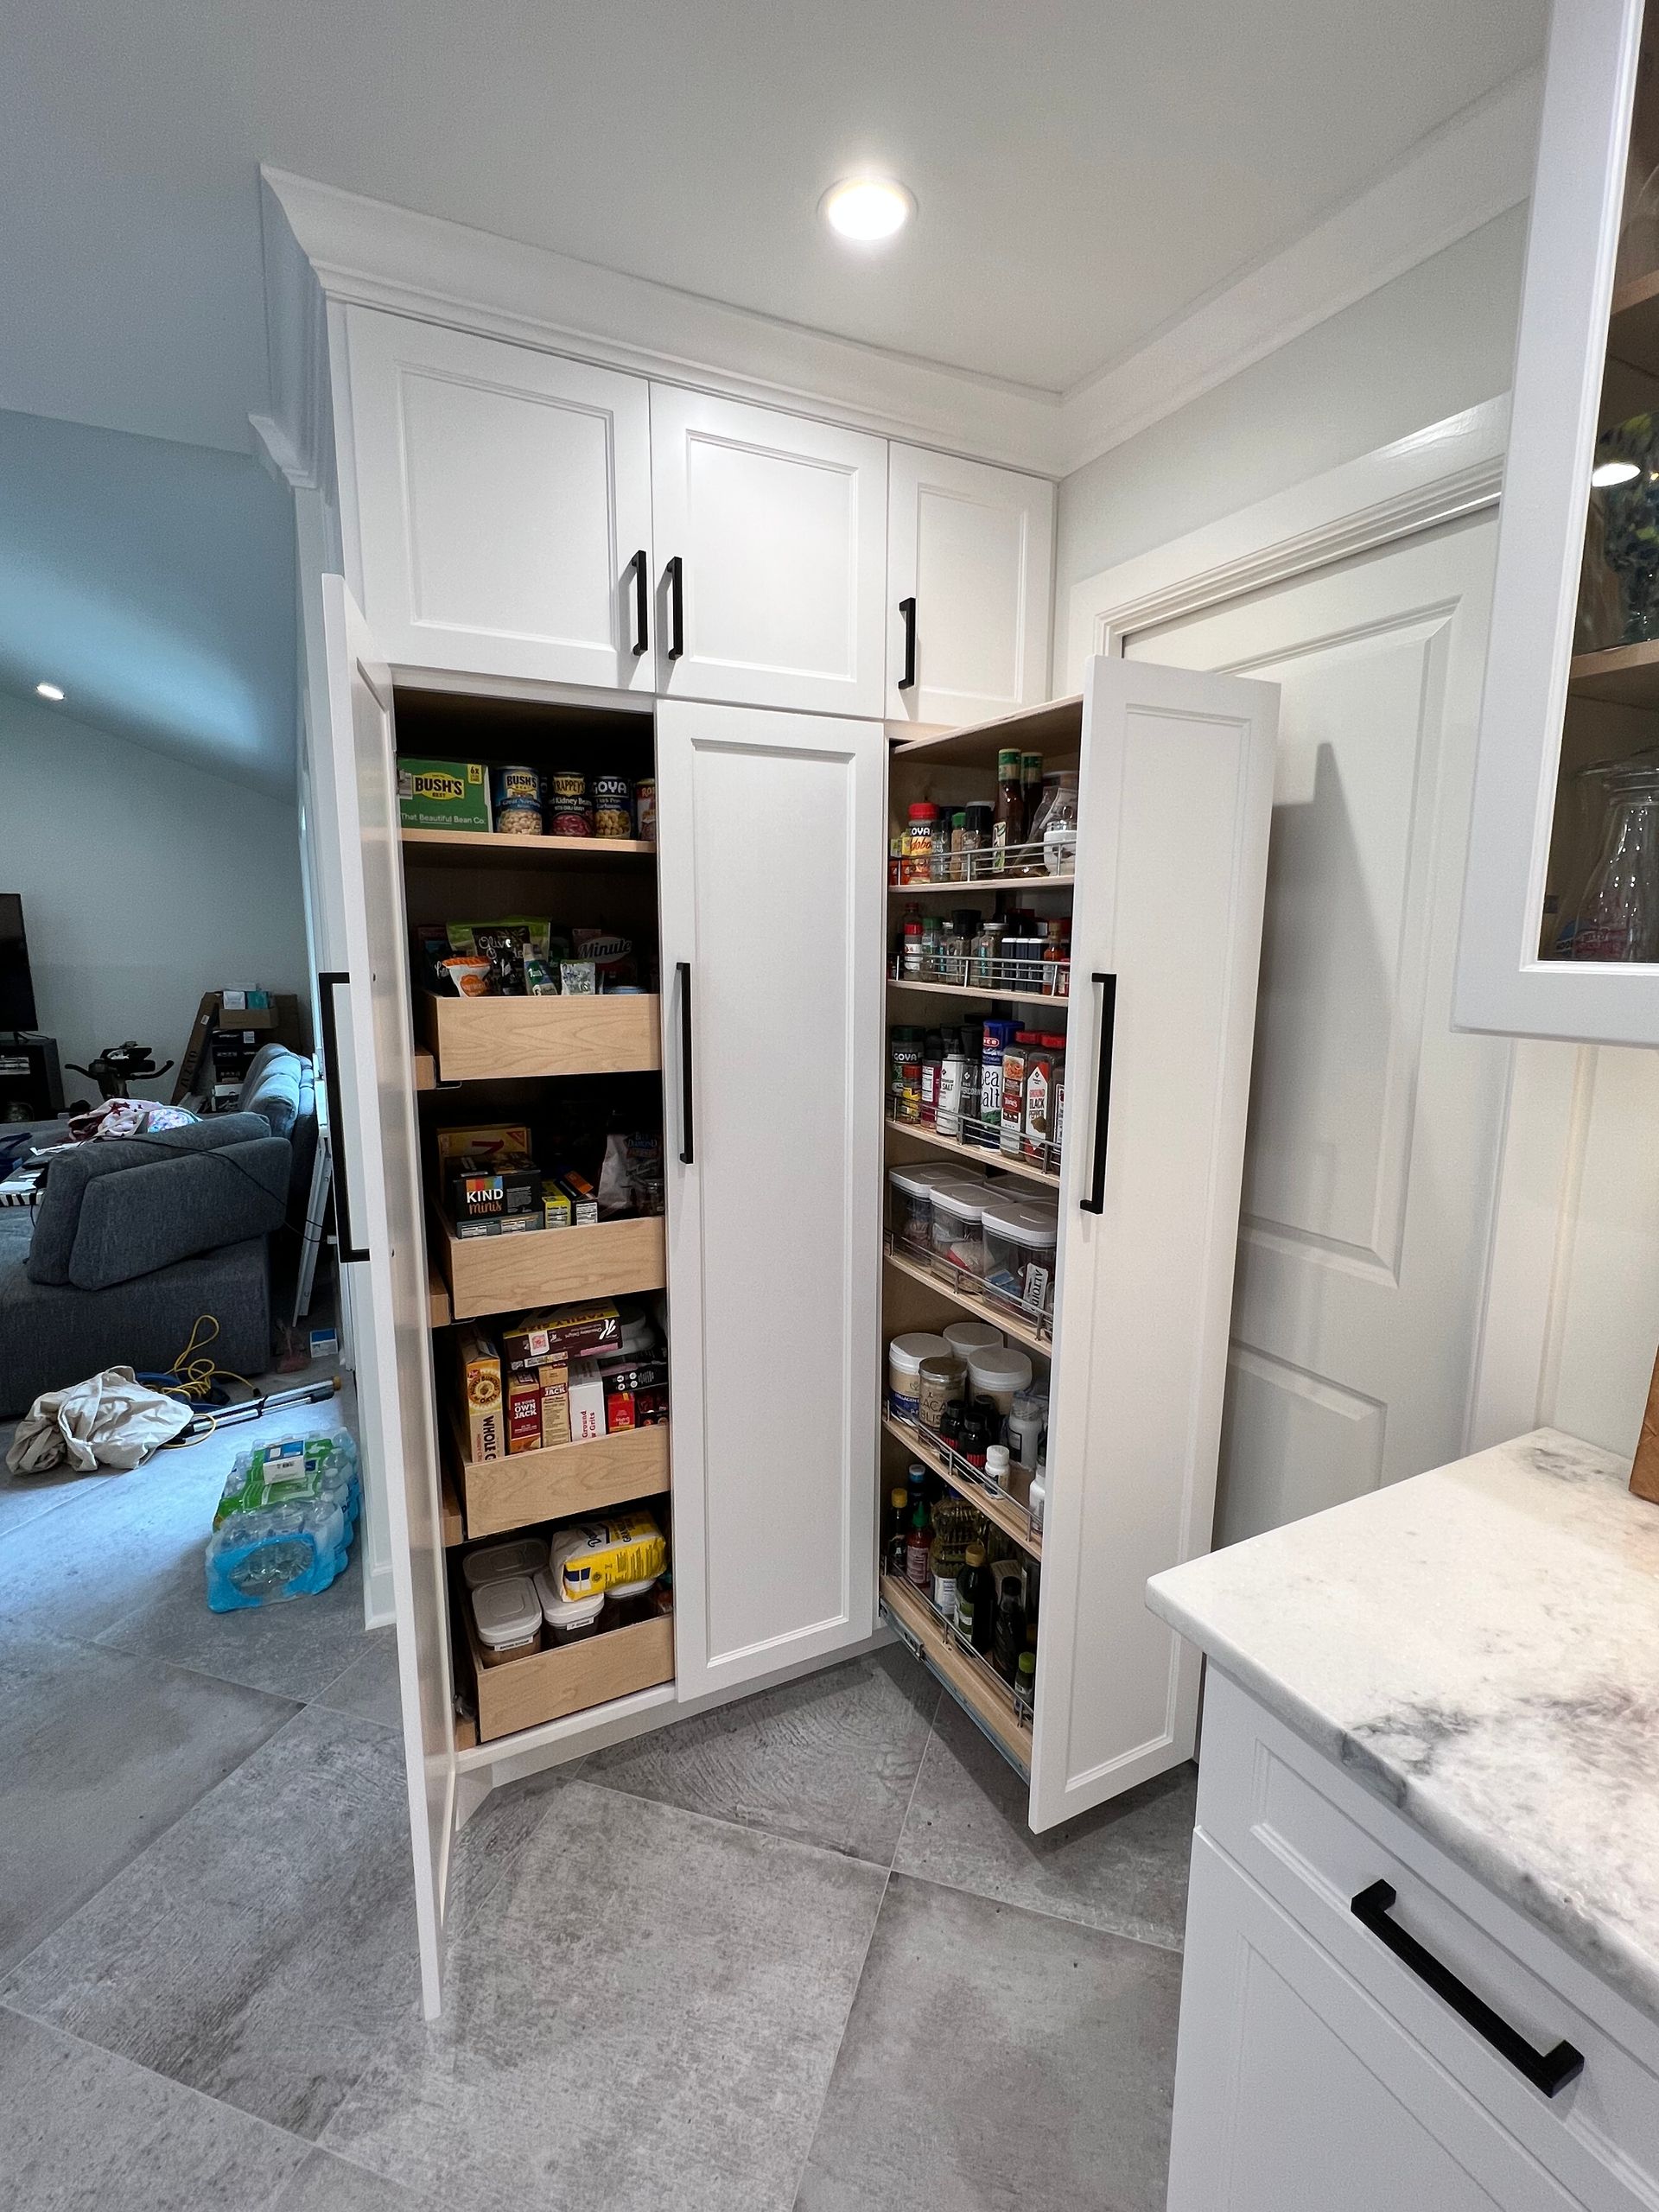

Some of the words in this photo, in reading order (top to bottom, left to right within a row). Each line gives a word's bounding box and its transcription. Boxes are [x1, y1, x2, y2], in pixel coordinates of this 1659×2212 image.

[470, 766, 480, 775] 6x
[415, 777, 462, 796] BUSH'S
[506, 775, 537, 788] BUSH'S
[555, 797, 578, 806] Kidney
[401, 812, 418, 821] That
[419, 813, 453, 823] Beautiful
[454, 815, 473, 824] Bean
[911, 827, 931, 836] OYA
[577, 939, 632, 959] Minute
[893, 1052, 918, 1061] GOYA
[942, 1083, 954, 1091] SALT
[982, 1088, 1000, 1108] alt
[467, 1189, 504, 1204] KIND
[469, 1200, 502, 1216] minis
[1031, 1268, 1043, 1312] ALTOID
[556, 1313, 605, 1326] FAMILY
[544, 1387, 566, 1396] JACK
[514, 1402, 536, 1413] OWN
[514, 1409, 537, 1420] JACK
[483, 1415, 496, 1452] WHOLE
